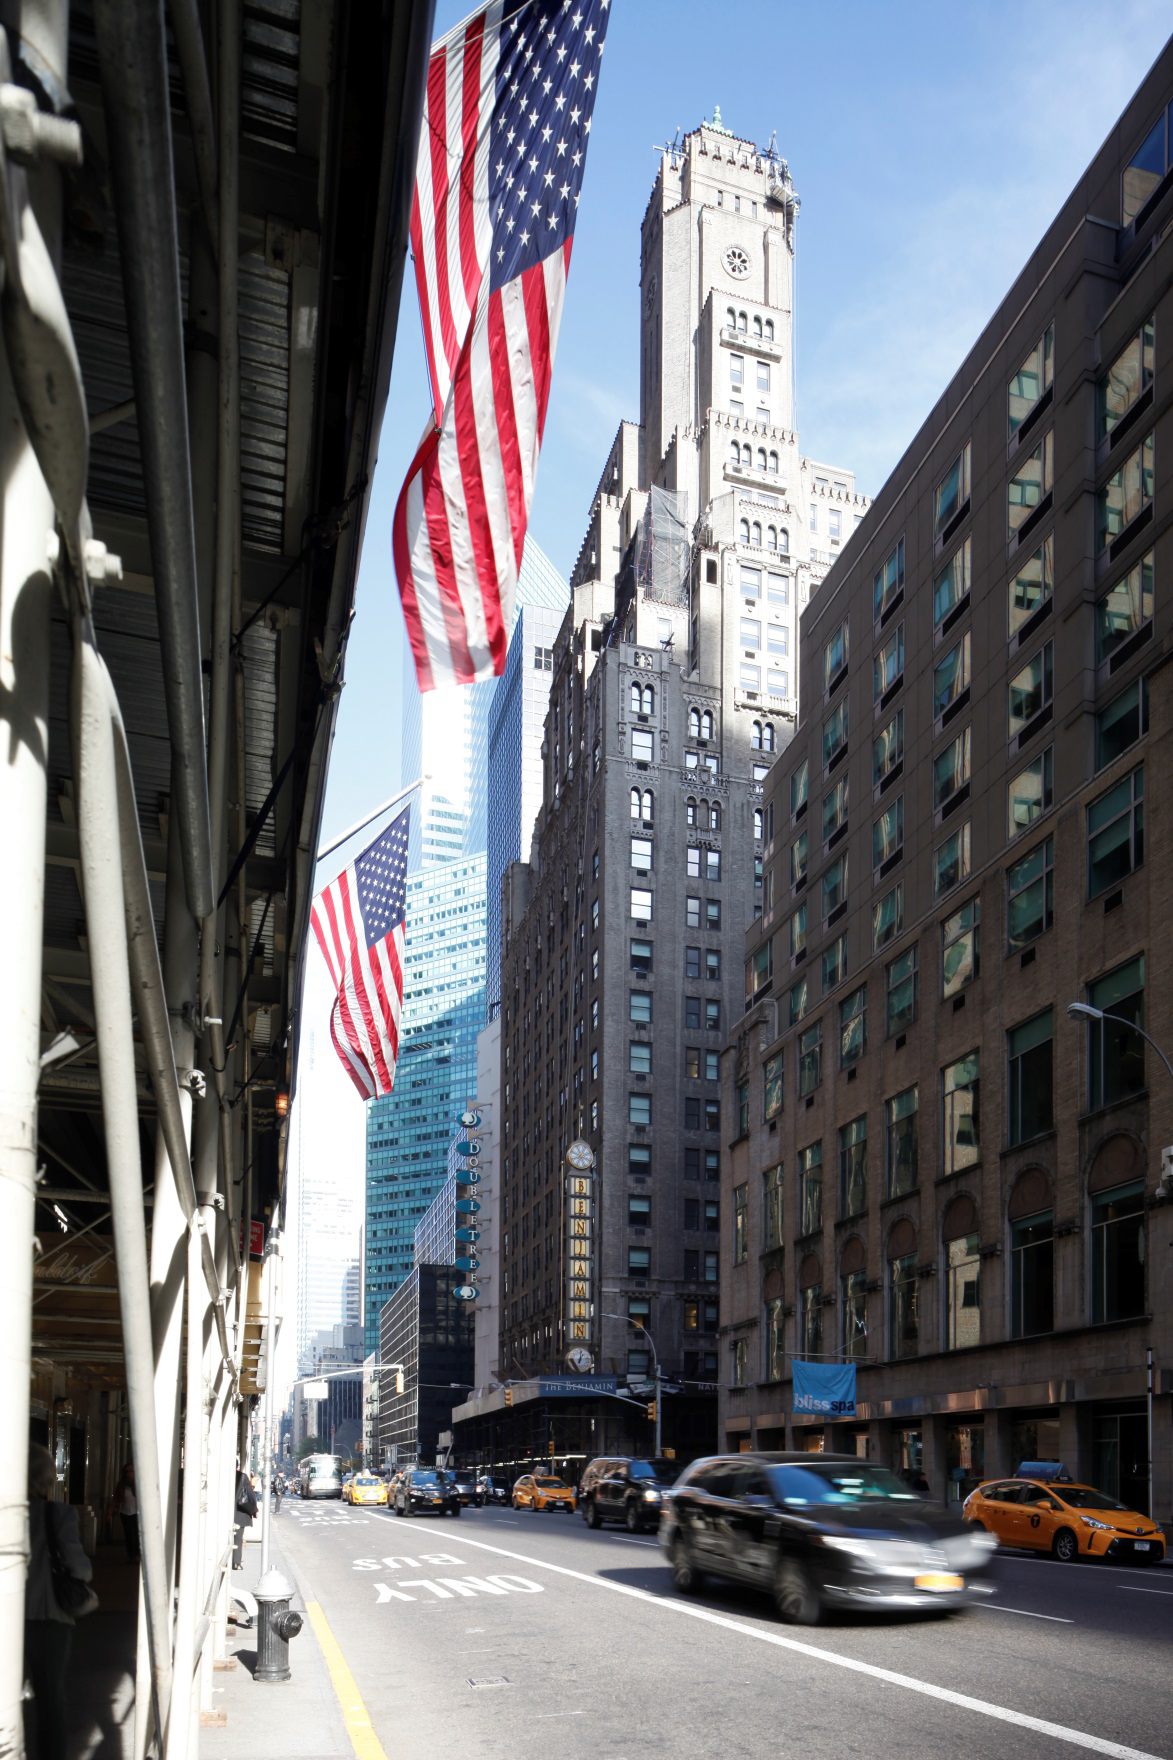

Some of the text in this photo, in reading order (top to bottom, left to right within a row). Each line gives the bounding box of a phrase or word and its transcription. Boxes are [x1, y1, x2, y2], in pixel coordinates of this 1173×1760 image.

[468, 1143, 480, 1283] DOUBLETREE
[576, 1180, 585, 1337] BENJAMIN
[545, 1381, 613, 1392] THE BENJAMIN
[794, 1393, 855, 1413] bliss spa
[352, 1553, 467, 1571] BUS
[373, 1575, 545, 1604] ONLY
